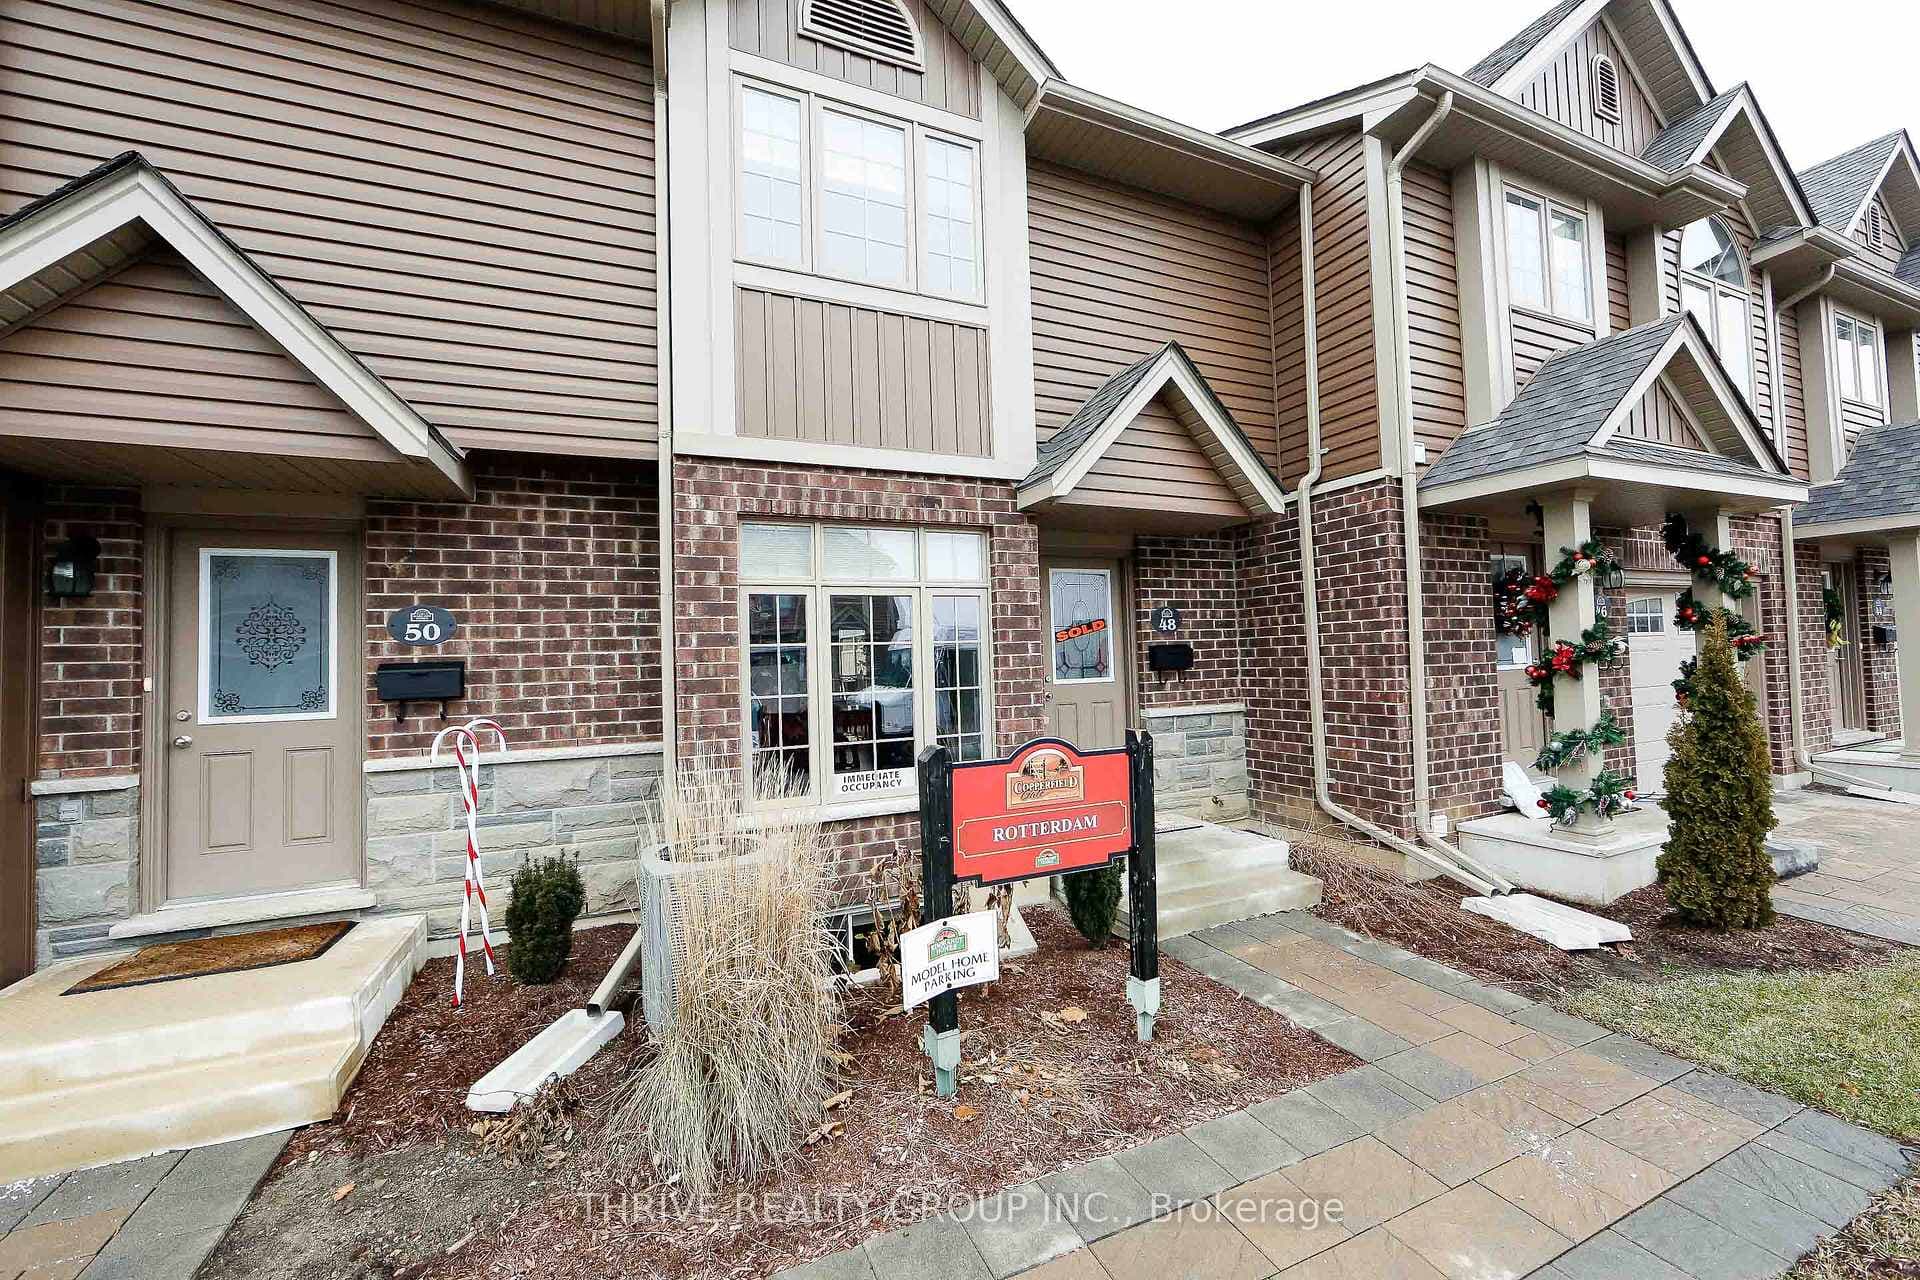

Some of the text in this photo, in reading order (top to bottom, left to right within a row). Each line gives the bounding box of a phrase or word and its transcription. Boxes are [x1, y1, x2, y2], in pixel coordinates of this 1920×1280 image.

[404, 623, 441, 641] 50
[1056, 620, 1105, 642] SOLD
[1159, 617, 1176, 631] 48
[841, 780, 902, 792] OCCUPANCY
[843, 771, 900, 783] IMMEDIATE
[992, 815, 1098, 842] ROTTERDAM
[911, 952, 989, 986] MODEL HOME
[923, 966, 976, 992] PARKING
